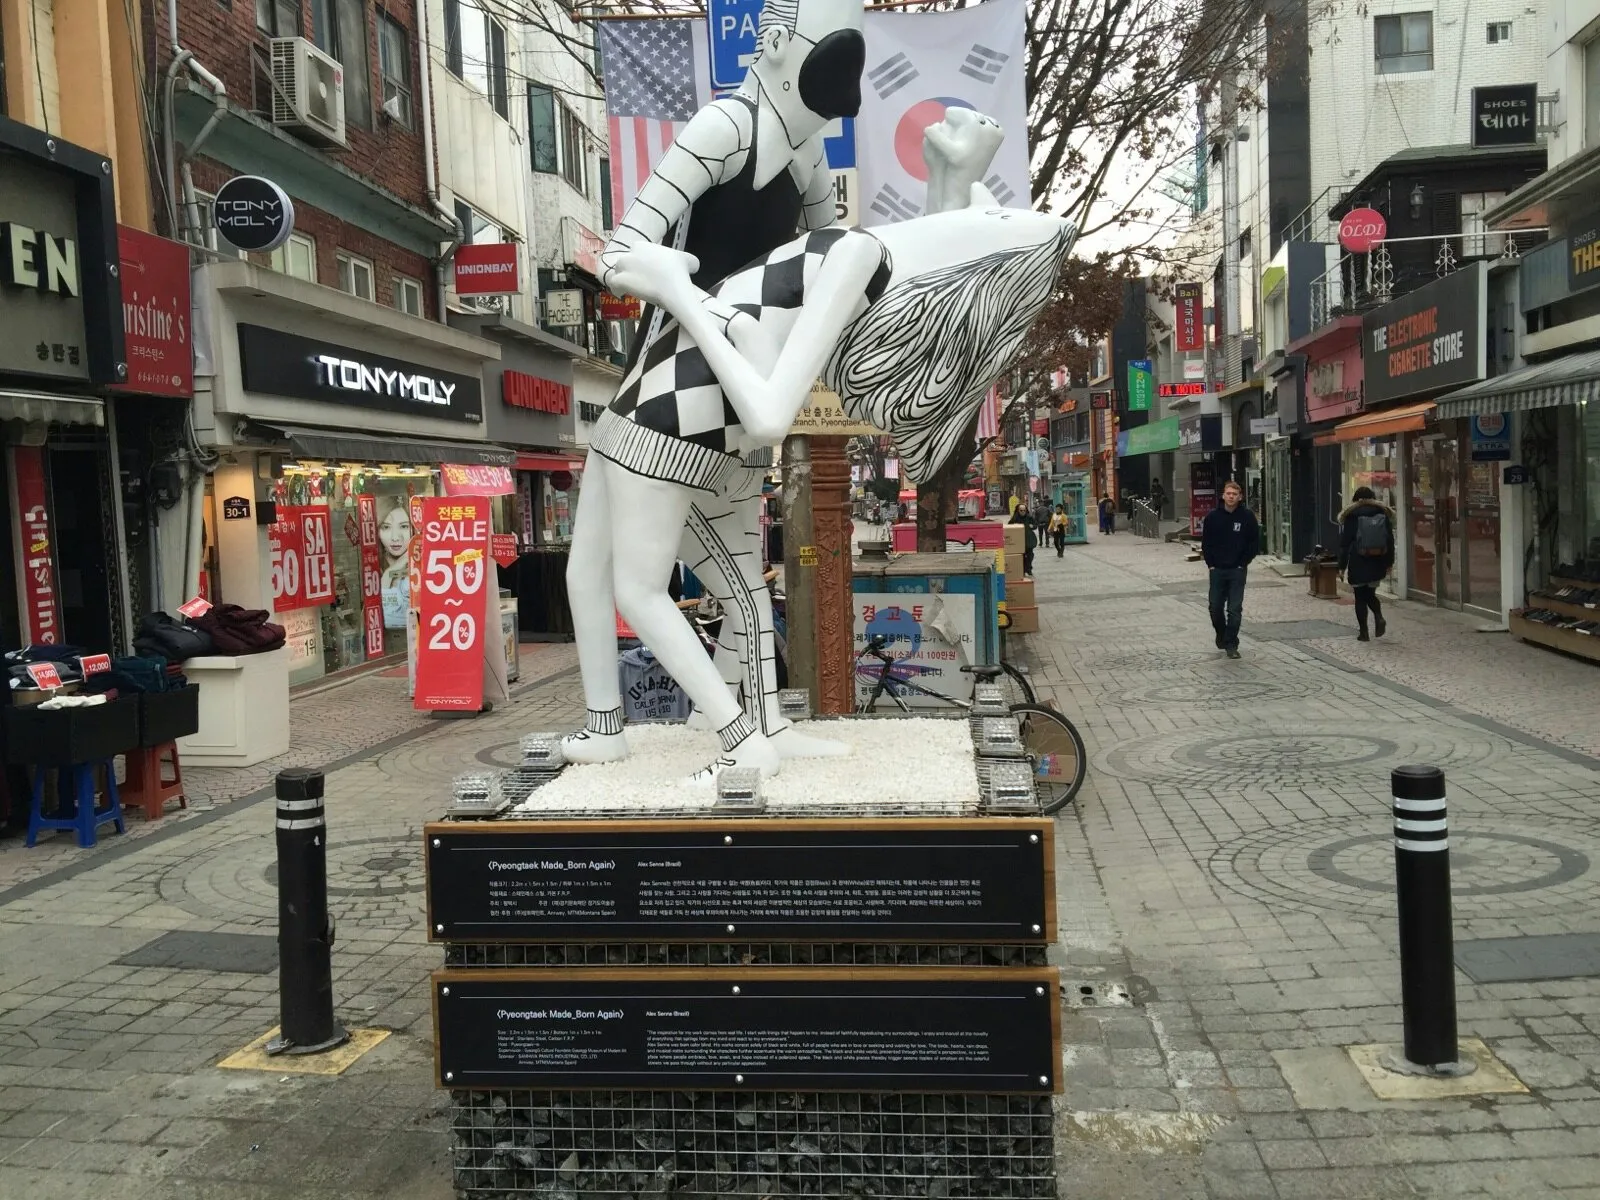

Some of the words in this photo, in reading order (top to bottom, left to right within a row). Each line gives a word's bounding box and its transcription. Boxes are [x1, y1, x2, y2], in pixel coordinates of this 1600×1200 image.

[721, 13, 759, 41] PA
[1483, 99, 1527, 109] SHOES
[217, 200, 279, 211] TONY
[218, 215, 281, 226] MOLY
[1342, 223, 1384, 238] OLDI
[3, 222, 79, 297] EN
[457, 263, 514, 275] UNIONBAY
[558, 293, 570, 306] THE
[1179, 288, 1198, 297] Bali
[549, 308, 581, 323] FACESHOP
[1184, 298, 1194, 346] 태국마사지
[1373, 329, 1387, 353] THE
[1388, 306, 1438, 347] ELECTRONIC
[1388, 349, 1433, 378] CIGARETTE
[1433, 330, 1464, 366] STORE
[318, 354, 456, 406] TONYMOLY
[504, 369, 572, 415] UNIONBAY
[478, 453, 511, 464] TONYMOLY
[226, 507, 247, 518] 30-1
[438, 506, 476, 521] 전품목
[425, 521, 487, 543] SALE
[927, 651, 957, 661] 100만원
